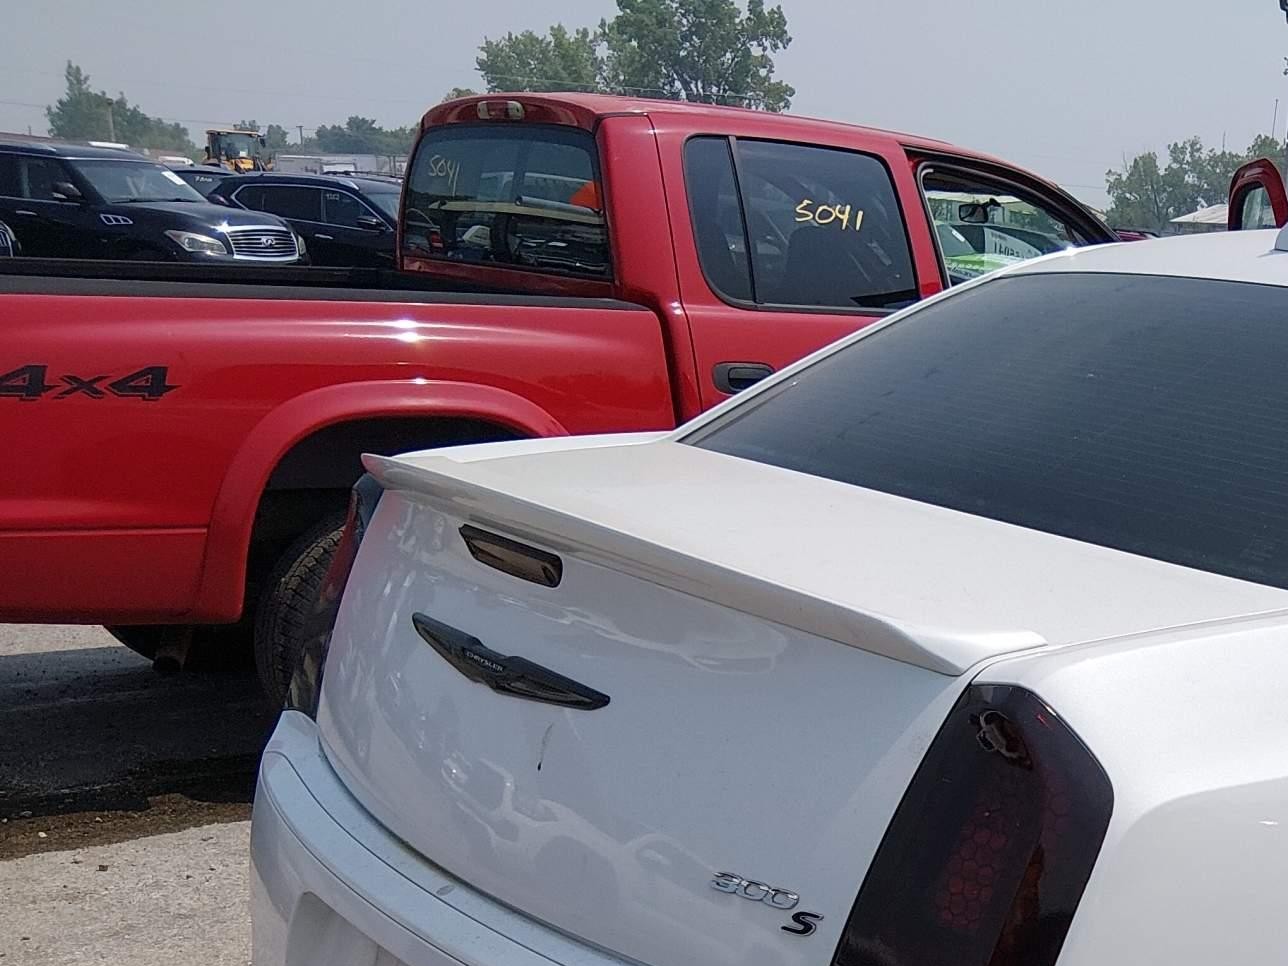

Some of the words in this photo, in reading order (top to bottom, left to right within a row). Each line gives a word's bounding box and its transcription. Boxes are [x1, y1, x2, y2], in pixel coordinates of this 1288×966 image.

[428, 154, 460, 197] 5041
[795, 199, 864, 231] 5041
[0, 363, 183, 401] 4x4
[710, 871, 800, 910] 300
[780, 911, 824, 937] S
